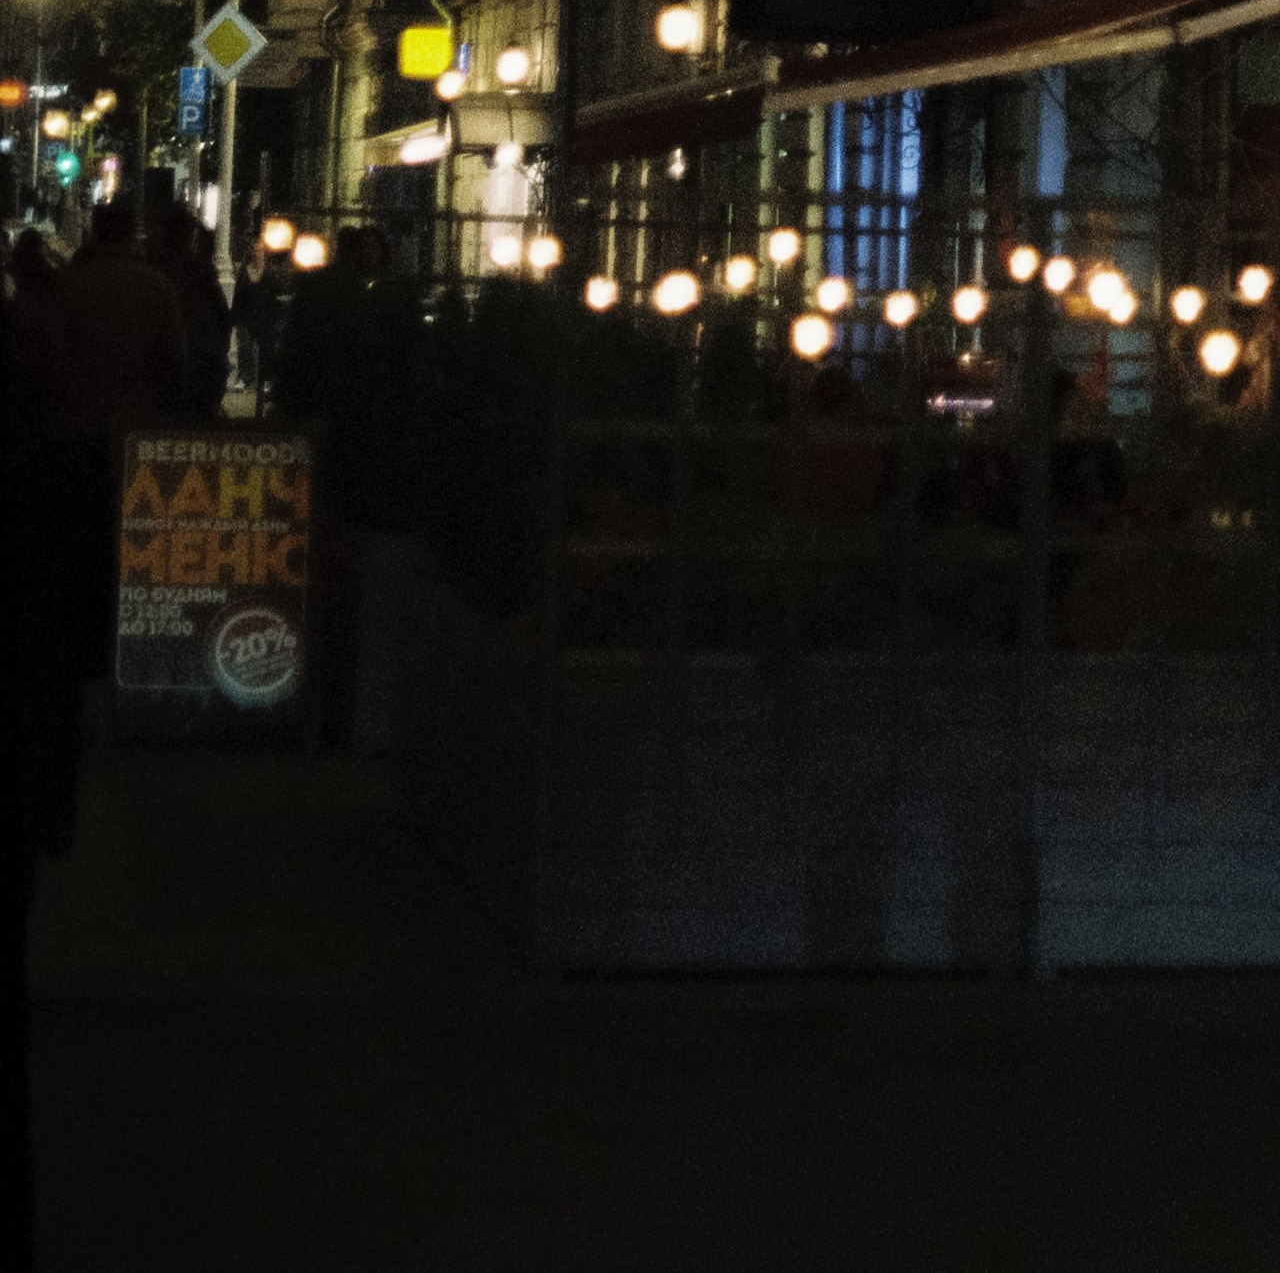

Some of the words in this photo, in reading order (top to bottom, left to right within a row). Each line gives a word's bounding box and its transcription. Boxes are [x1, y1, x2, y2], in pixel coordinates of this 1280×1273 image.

[182, 105, 200, 131] P
[122, 463, 311, 522] ЛАНЧ
[118, 587, 147, 603] ПО
